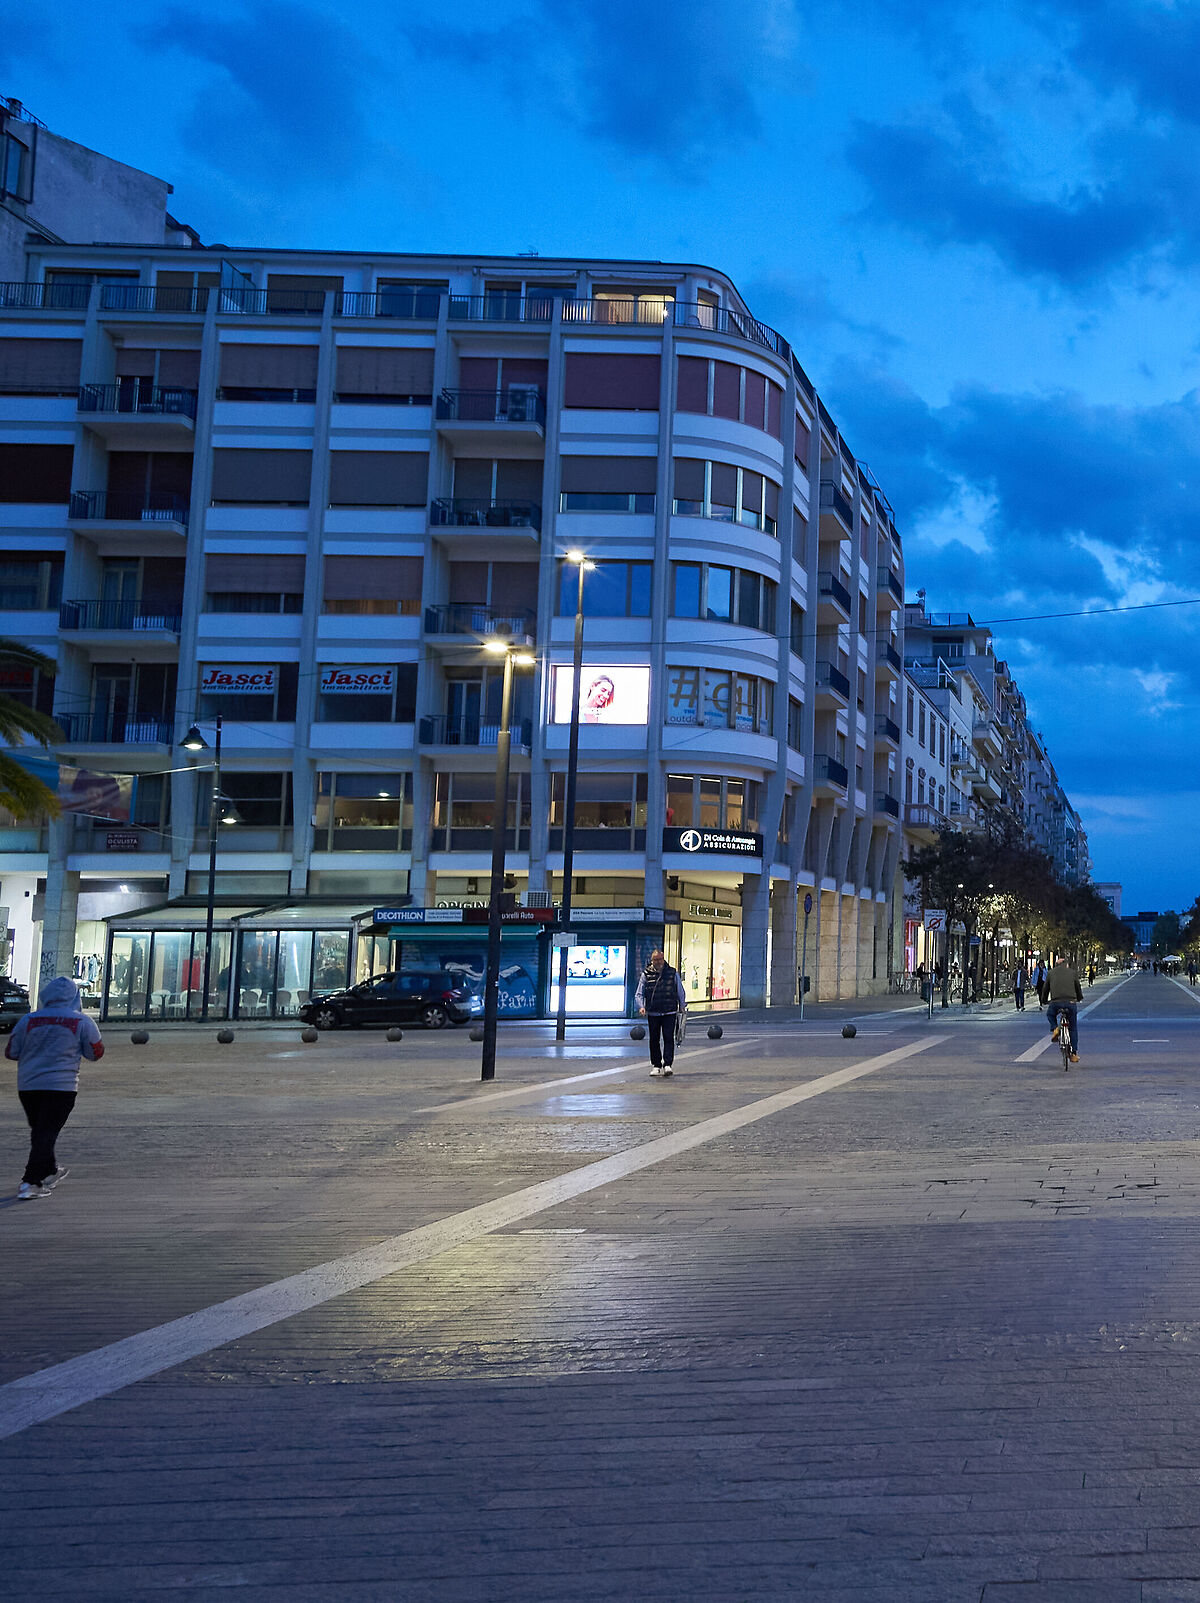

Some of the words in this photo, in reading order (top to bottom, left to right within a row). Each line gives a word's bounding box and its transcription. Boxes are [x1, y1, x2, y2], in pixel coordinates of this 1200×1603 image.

[203, 670, 274, 685] Jasci
[322, 670, 393, 685] Jasci
[703, 841, 756, 852] ASSICURAZIONI
[376, 911, 424, 920] DECATHLON
[520, 911, 535, 920] Auto
